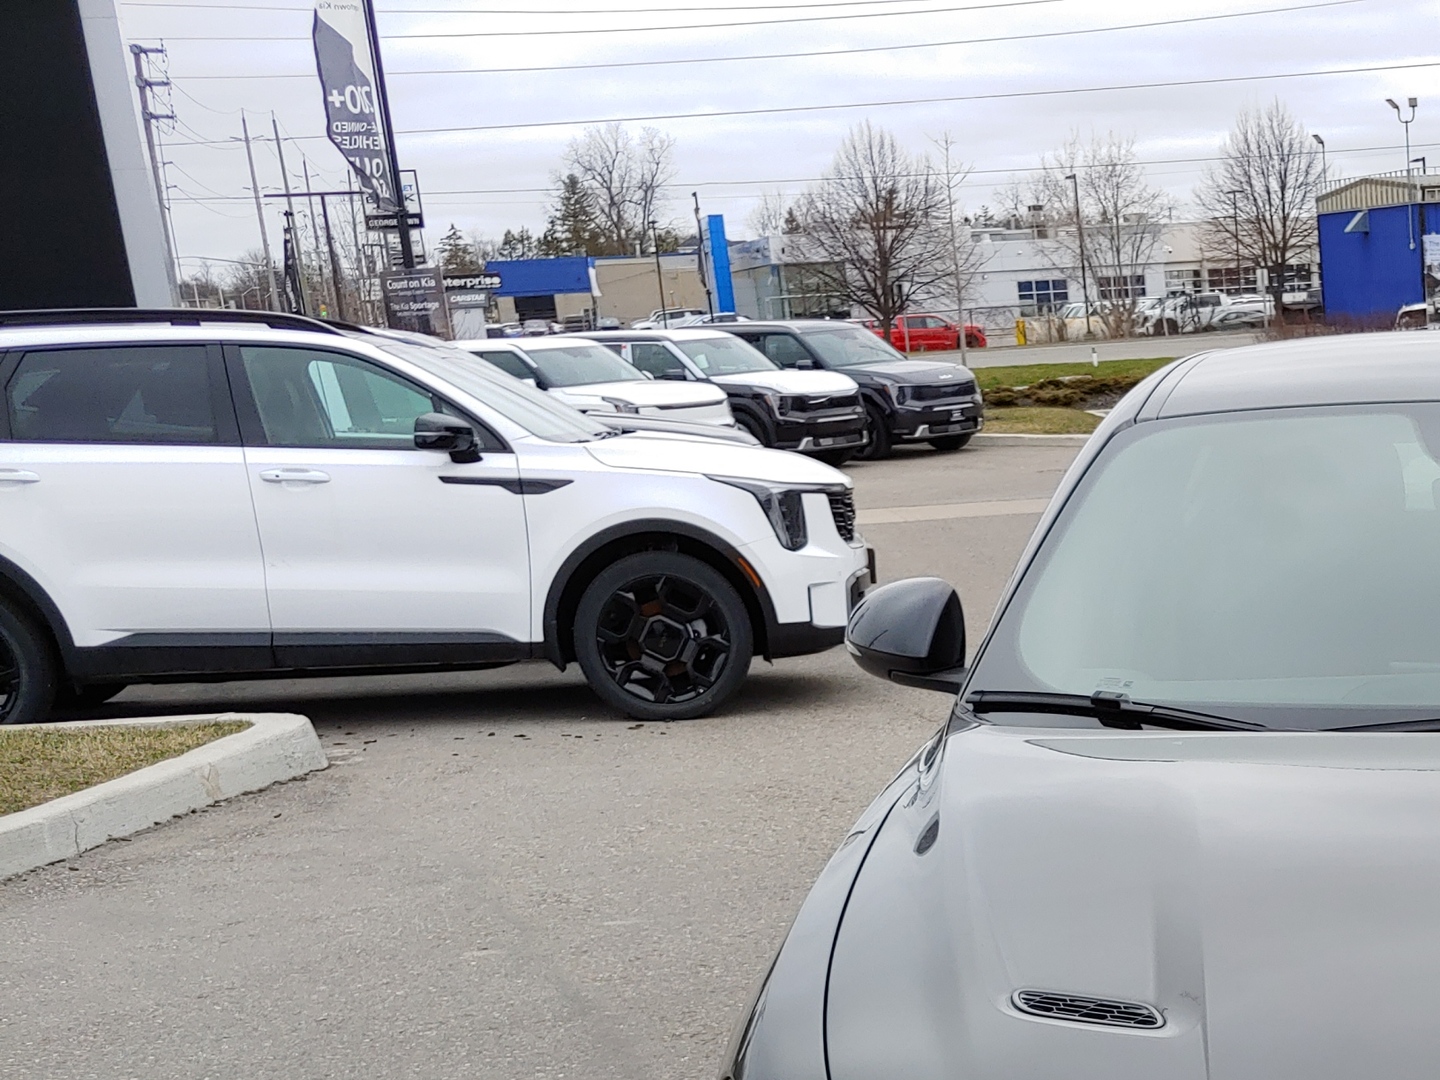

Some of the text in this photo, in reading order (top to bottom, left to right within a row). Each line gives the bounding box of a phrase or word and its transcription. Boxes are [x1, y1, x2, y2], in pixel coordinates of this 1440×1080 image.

[387, 277, 436, 289] Count on Kia
[450, 293, 486, 302] CARSTAR
